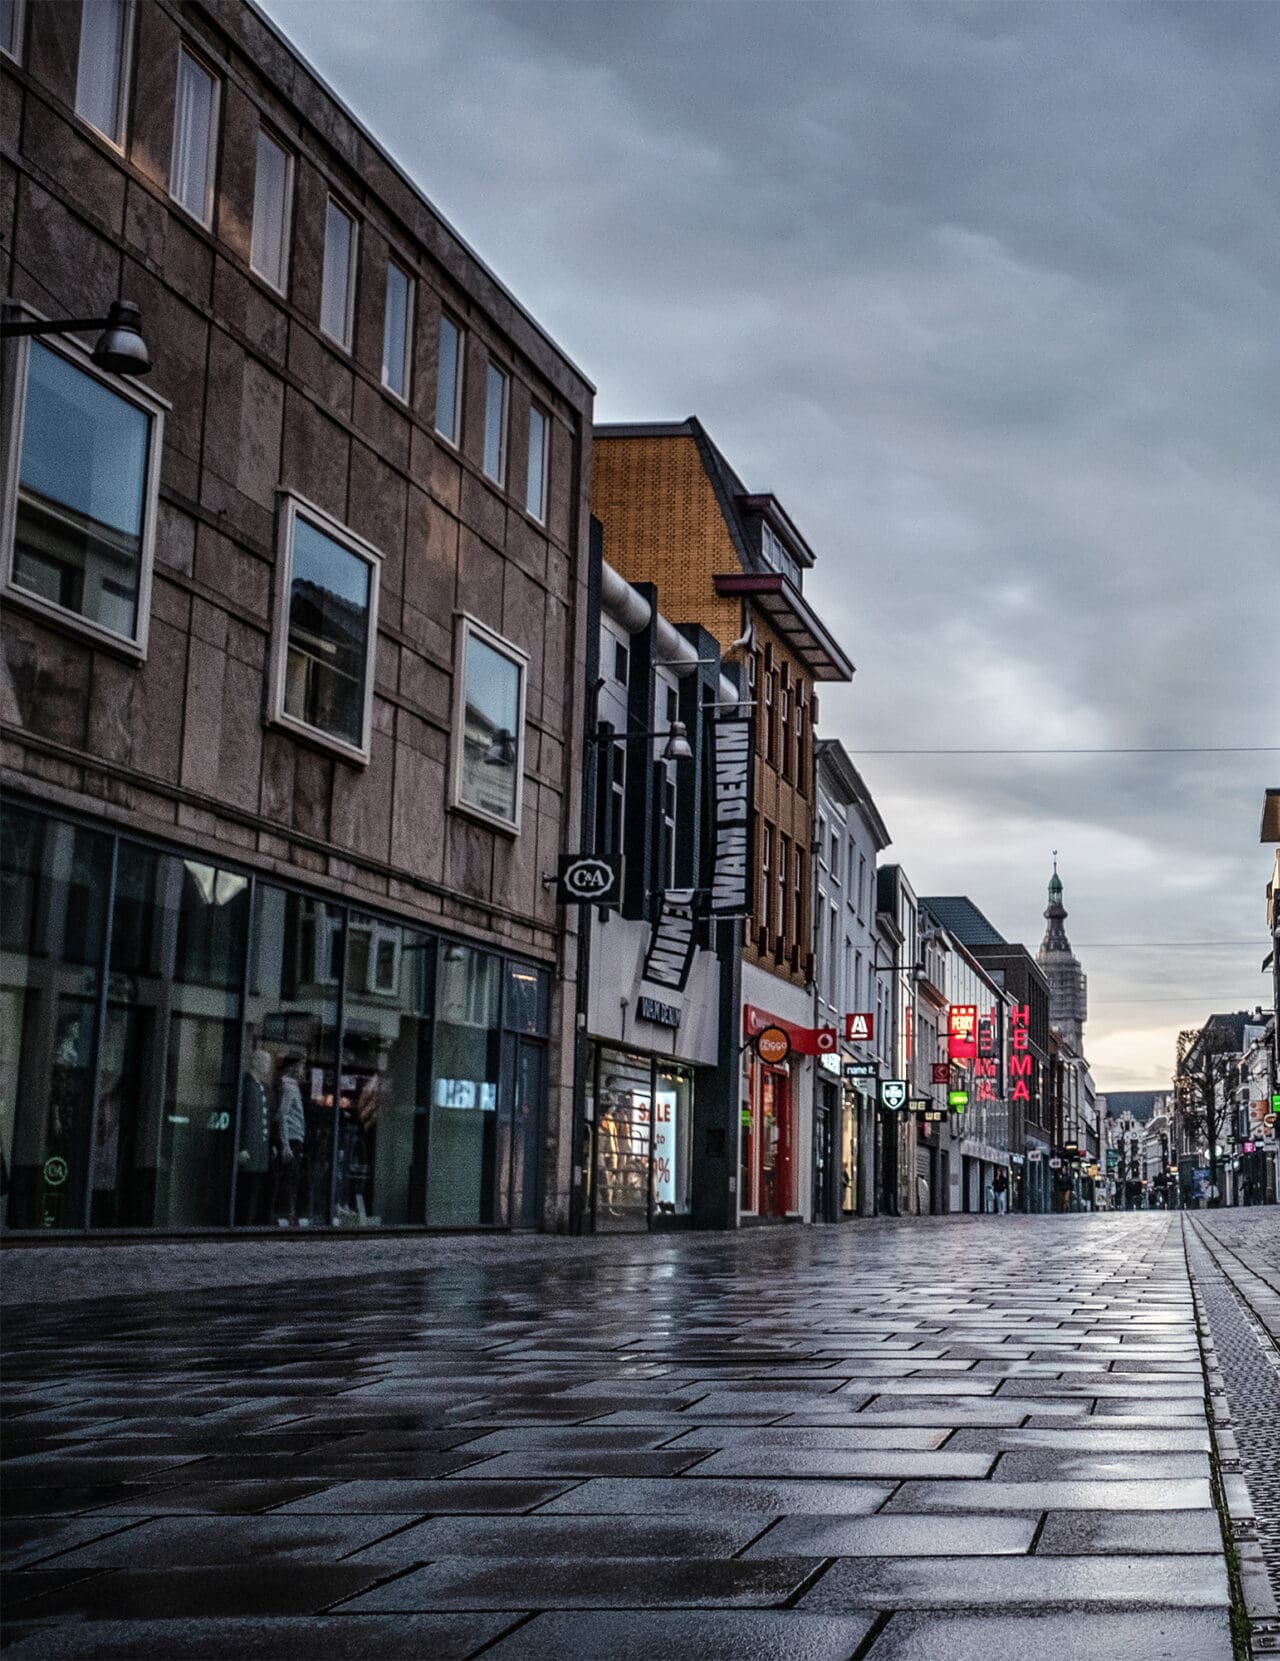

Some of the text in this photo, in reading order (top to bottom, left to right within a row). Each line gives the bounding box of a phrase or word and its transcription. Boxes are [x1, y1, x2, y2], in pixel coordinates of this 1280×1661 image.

[712, 722, 749, 909] WAM DENIM
[573, 869, 605, 888] C&A
[1010, 1005, 1032, 1101] HEMA
[638, 1103, 671, 1122] SLE
